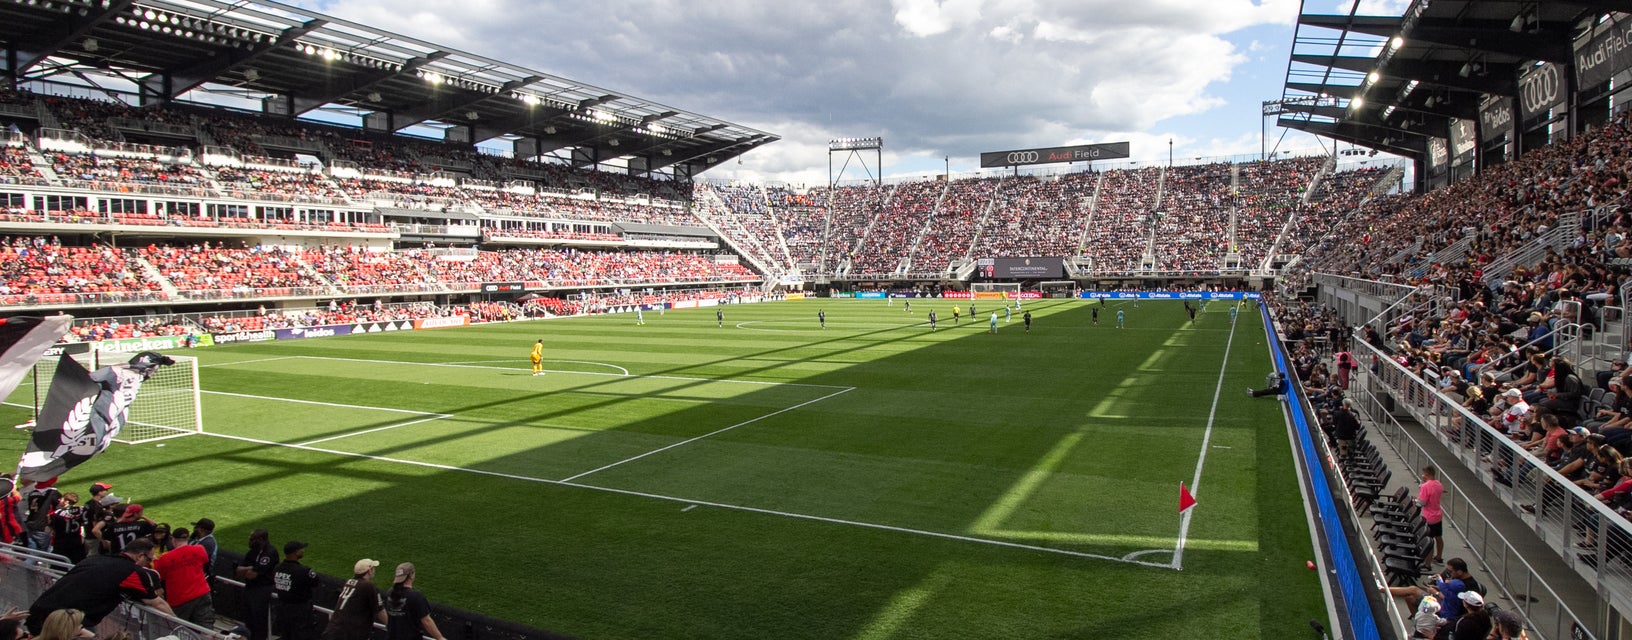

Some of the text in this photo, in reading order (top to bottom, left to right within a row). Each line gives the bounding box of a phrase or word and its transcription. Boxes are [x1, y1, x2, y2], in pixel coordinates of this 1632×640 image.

[1579, 43, 1606, 73] Audi
[1048, 149, 1100, 161] Audi Field
[214, 329, 275, 344] sport&health
[304, 328, 335, 338] leidos
[91, 336, 173, 353] Heineken
[65, 519, 80, 534] 15
[274, 572, 292, 580] APEX
